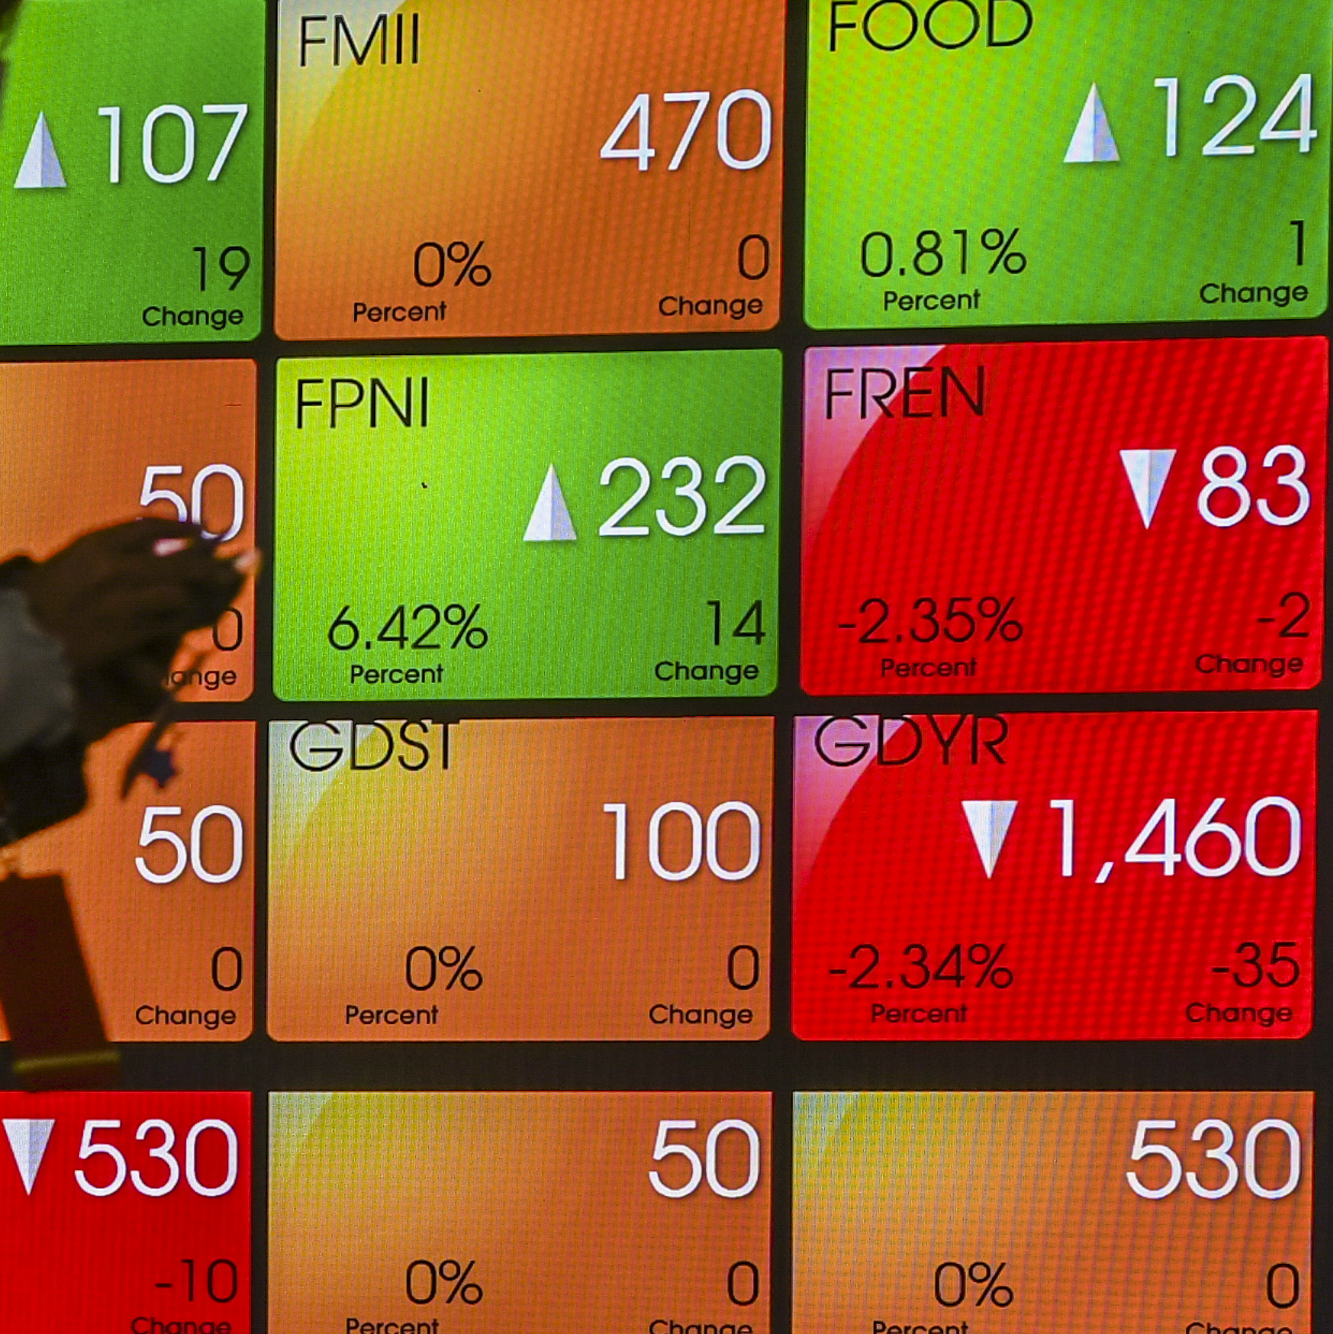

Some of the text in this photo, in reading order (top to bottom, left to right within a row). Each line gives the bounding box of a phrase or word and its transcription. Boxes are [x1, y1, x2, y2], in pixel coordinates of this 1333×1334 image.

[299, 13, 420, 67] FMII
[829, 0, 1033, 52] FOOD
[599, 88, 773, 171] 470
[1153, 73, 1318, 157] 124
[97, 103, 249, 185] 107
[414, 241, 492, 288] 0%
[738, 234, 770, 280] 0
[861, 227, 1027, 279] 0.81%
[1289, 220, 1304, 266] 1
[192, 246, 251, 292] 19
[142, 303, 244, 329] Change
[353, 301, 447, 324] Percent
[658, 293, 764, 320] Change
[883, 289, 981, 312] Percent
[1199, 281, 1309, 307] Change
[295, 376, 429, 430] FPNI
[826, 366, 986, 420] FREN
[598, 455, 767, 537] 232
[1197, 443, 1311, 528] 83
[327, 603, 489, 651] 6.42%
[708, 600, 766, 647] 14
[837, 596, 1024, 645] -2.35%
[1256, 592, 1311, 639] -2
[168, 669, 237, 692] ange
[349, 664, 443, 686] Percent
[654, 660, 760, 686] Change
[880, 657, 977, 679] Percent
[1195, 653, 1304, 679] Change
[289, 720, 458, 772] GDST
[814, 714, 1009, 767] GDYR
[134, 804, 244, 885] 50
[602, 801, 762, 882] 100
[1049, 796, 1303, 884] 1,460
[212, 947, 243, 992] 0
[405, 946, 483, 992] 0%
[727, 945, 760, 992] 0
[828, 943, 1014, 990] -2.34%
[1211, 941, 1300, 989] -35
[135, 1004, 237, 1029] Change
[345, 1004, 439, 1026] Percent
[649, 1003, 754, 1030] Change
[871, 1002, 968, 1025] Percent
[1186, 1001, 1294, 1028] Change
[73, 1118, 238, 1198] 530
[648, 1118, 760, 1199] 50
[1126, 1118, 1302, 1200] 530
[155, 1258, 238, 1304] -10
[405, 1259, 483, 1305] 0%
[727, 1261, 760, 1307] 0
[933, 1261, 1014, 1308] 0%
[1266, 1263, 1300, 1309] 0
